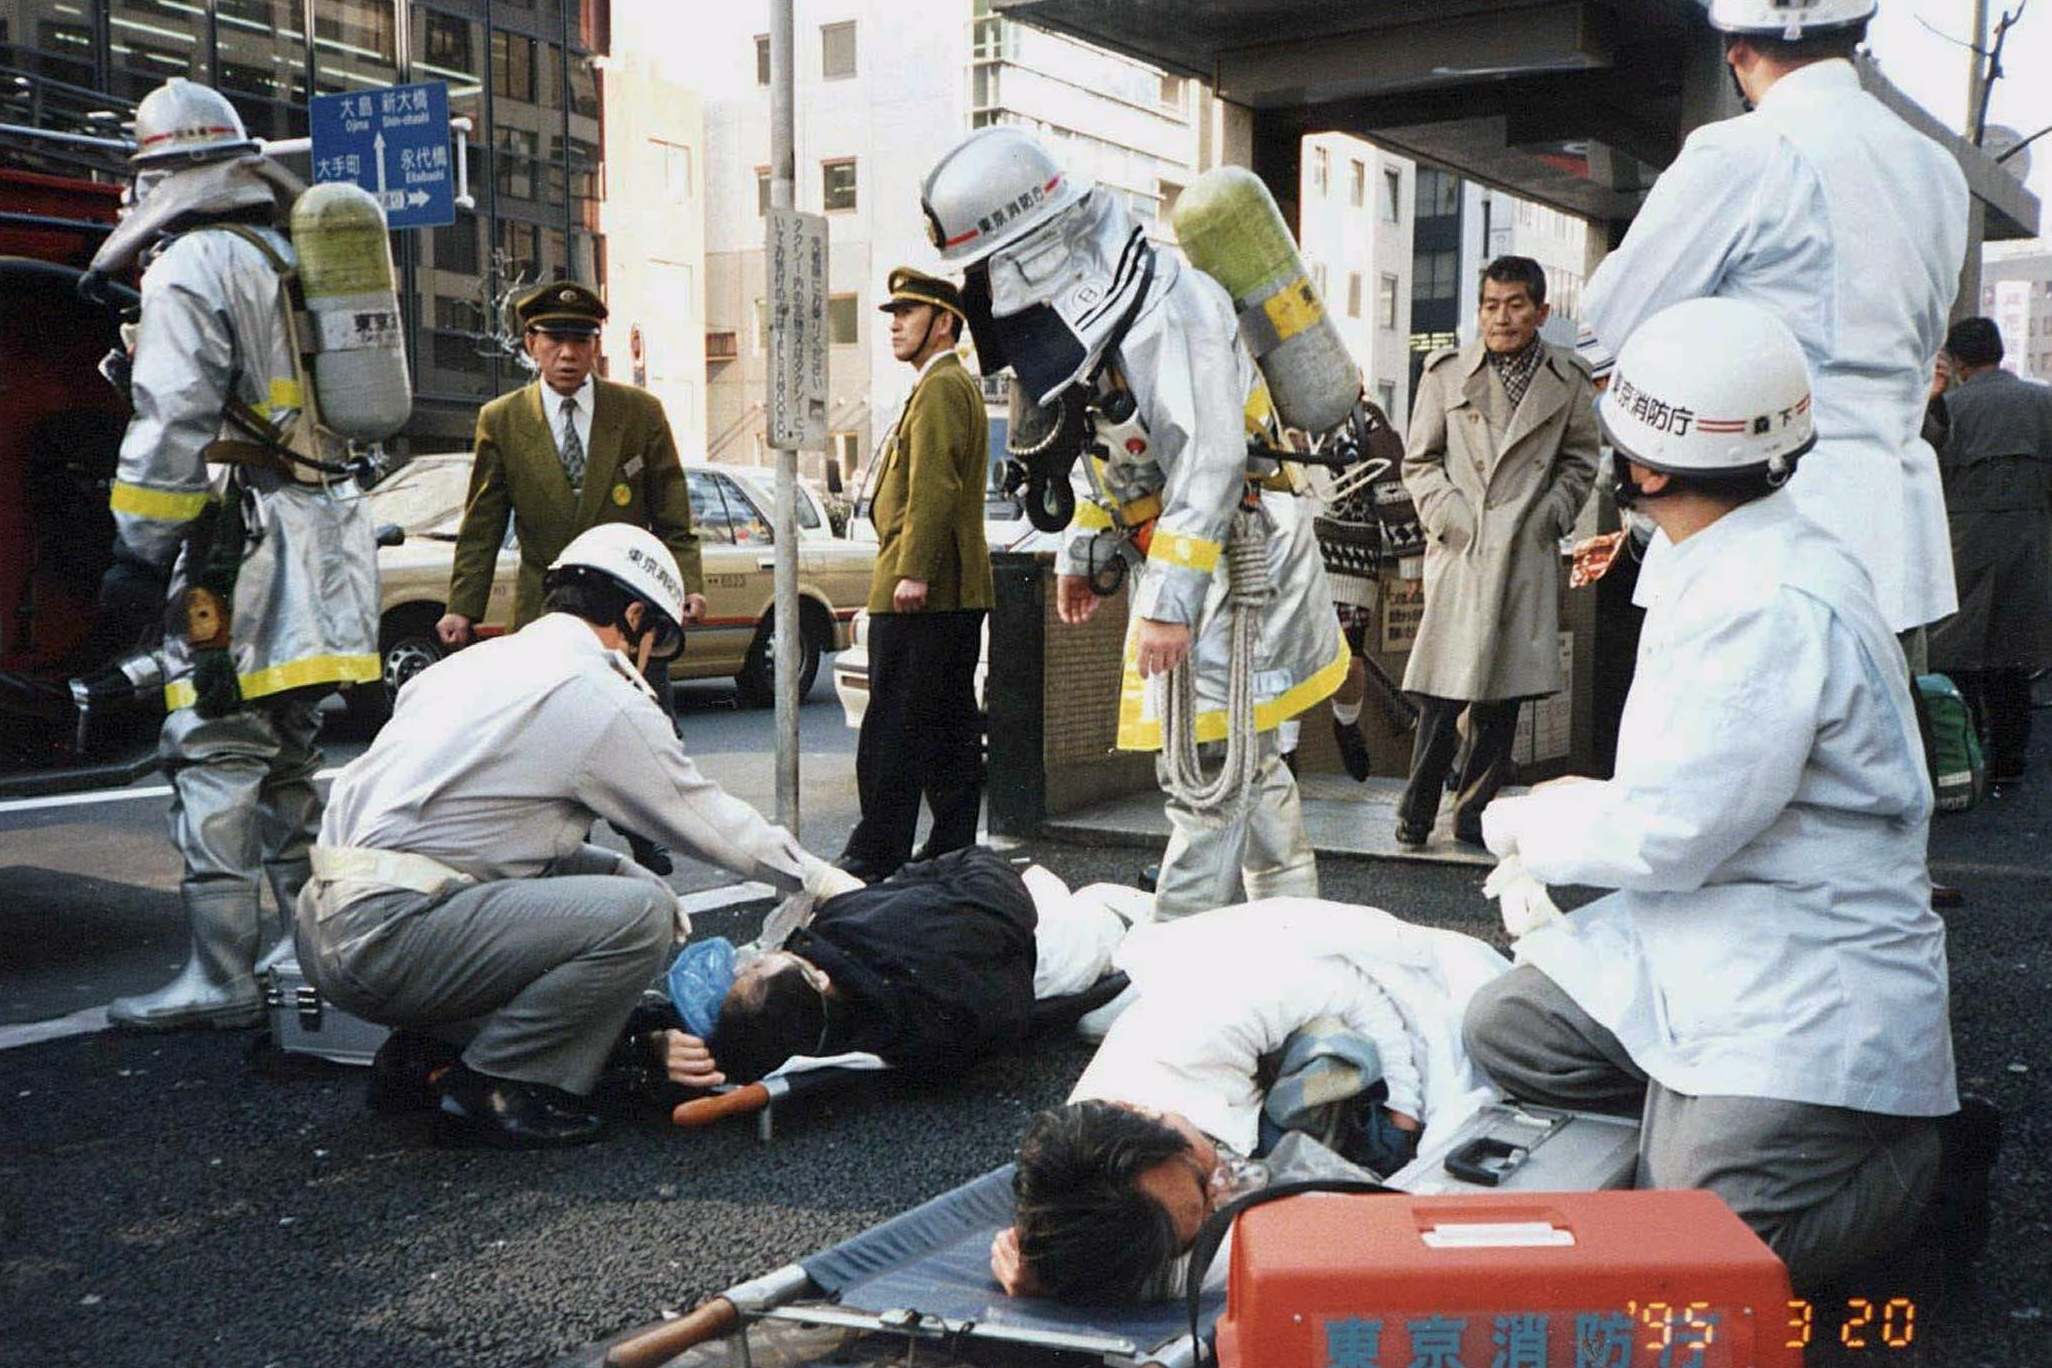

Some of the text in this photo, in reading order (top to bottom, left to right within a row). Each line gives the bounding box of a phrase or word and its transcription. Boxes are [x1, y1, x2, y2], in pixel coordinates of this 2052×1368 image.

[340, 88, 428, 119] 大島 新大橋
[317, 154, 360, 178] 大手町
[978, 185, 1045, 236] 東京消防庁
